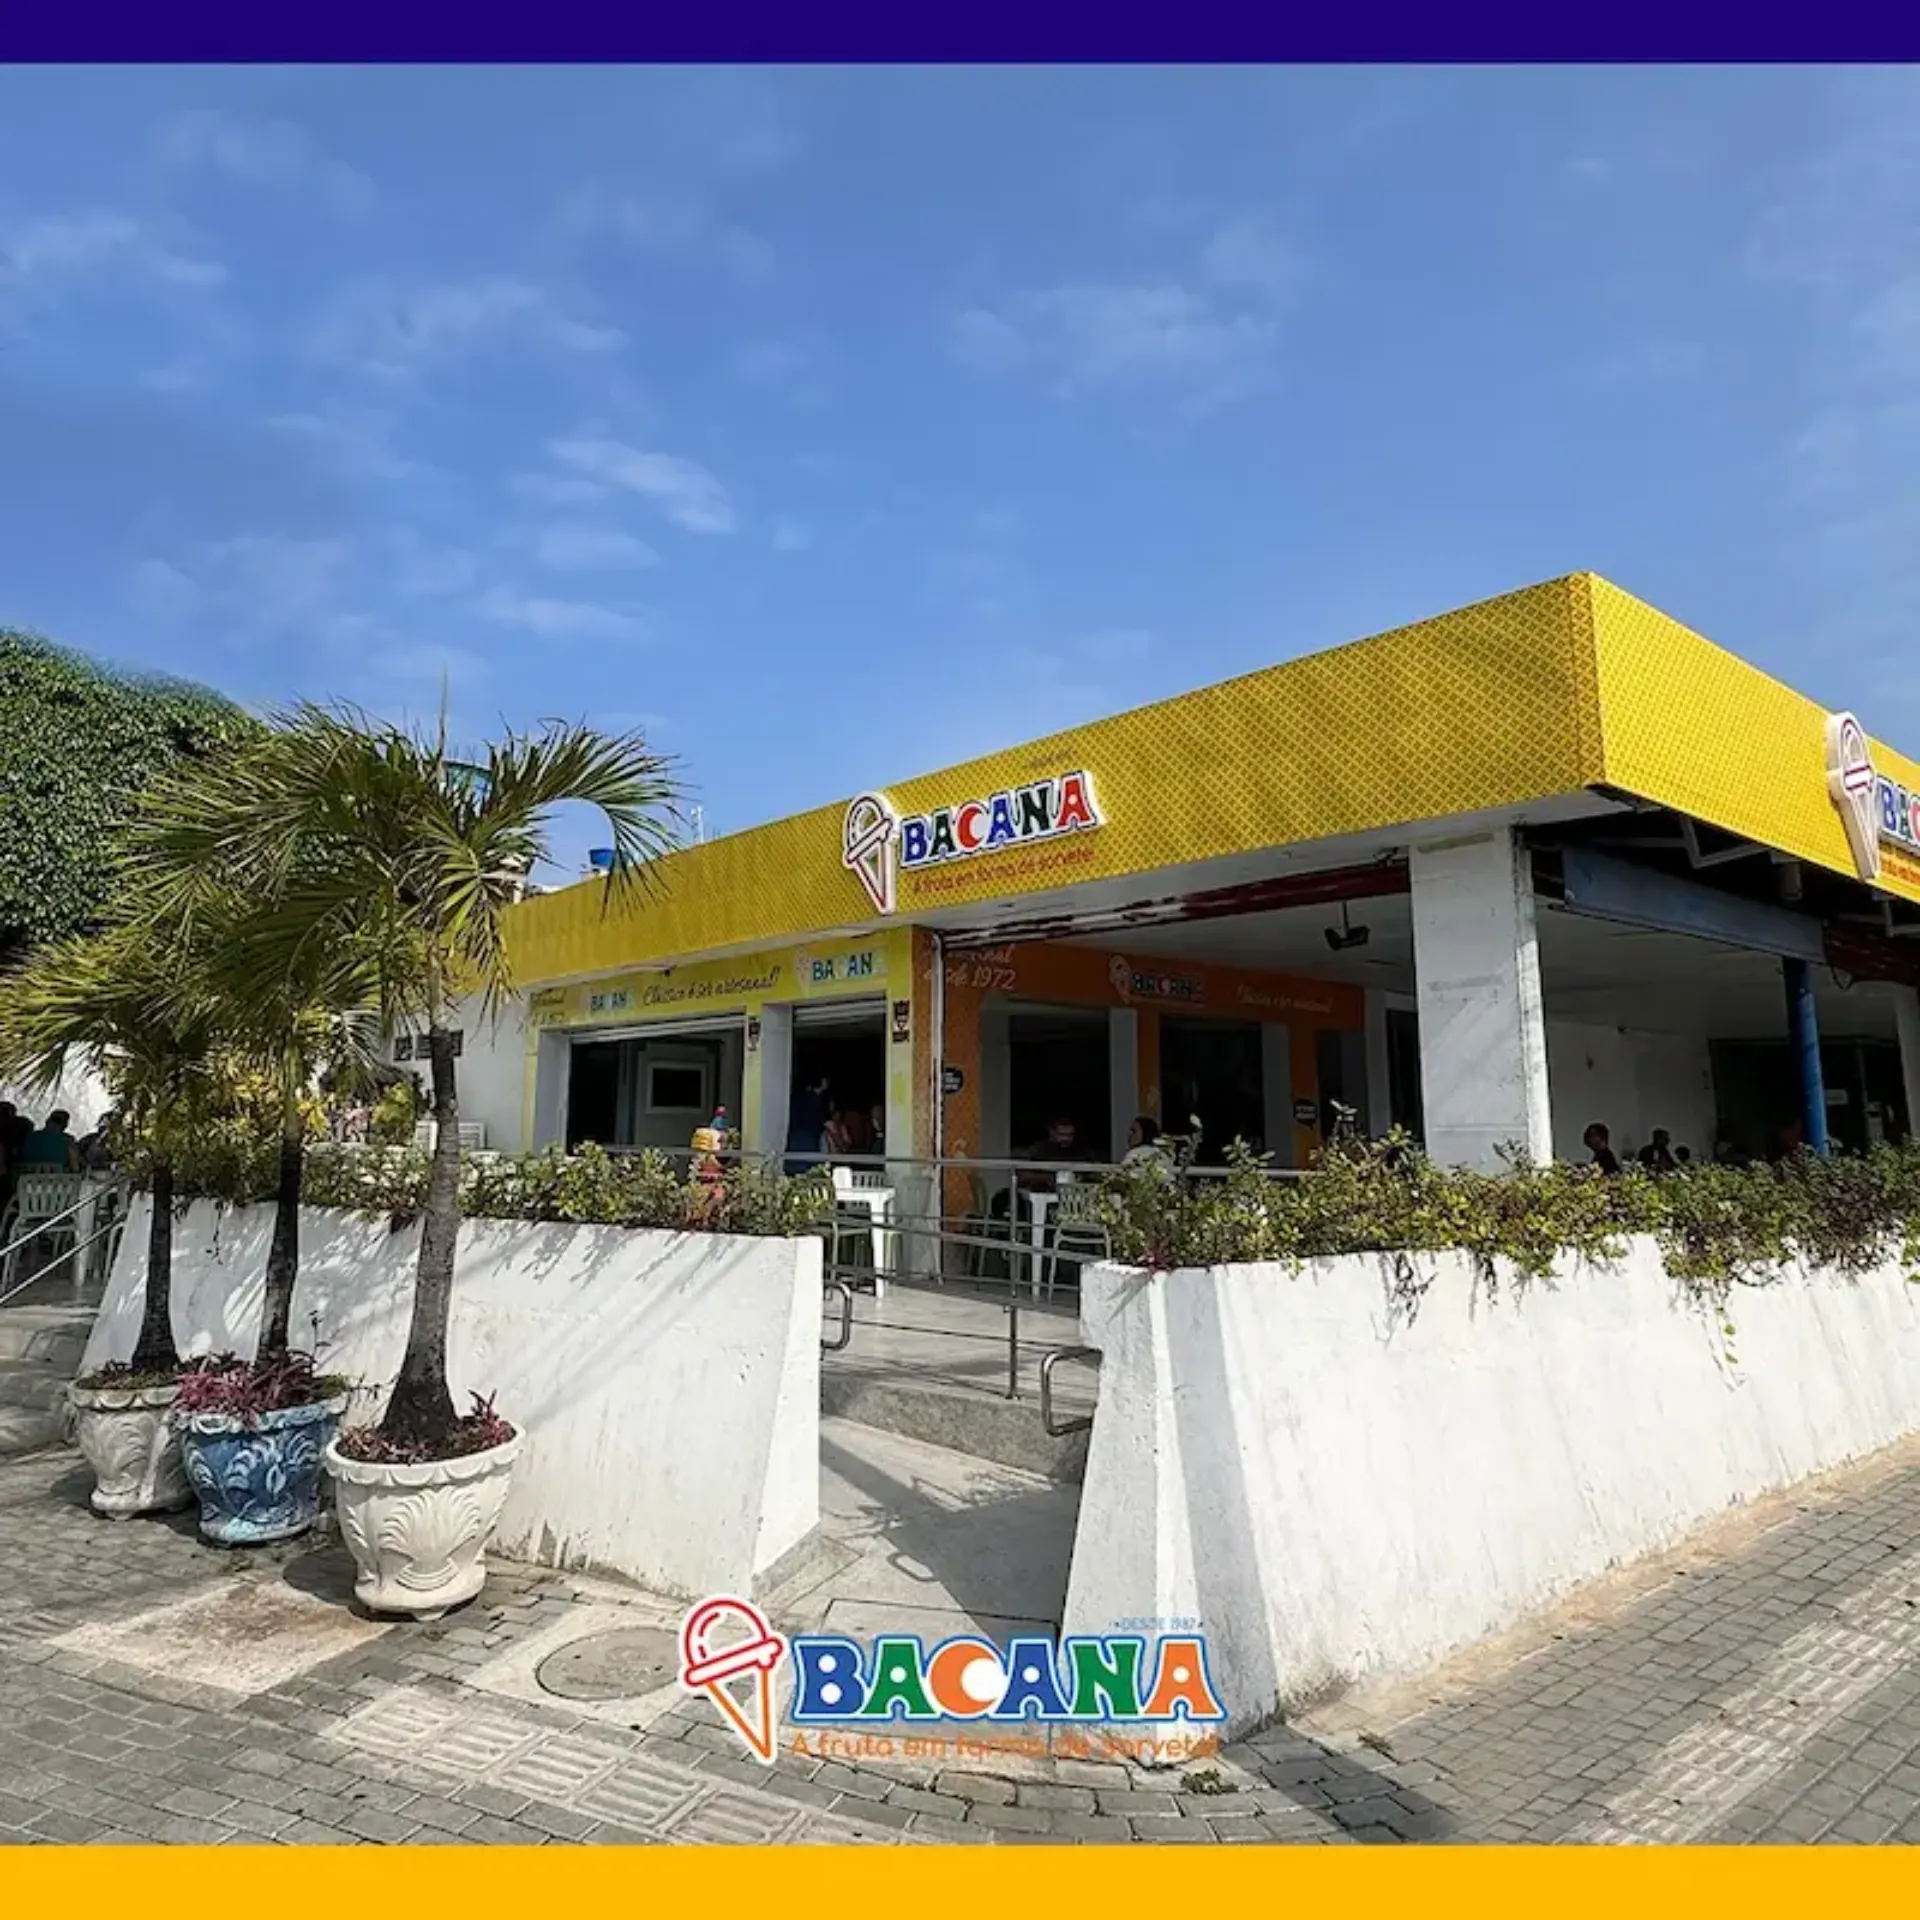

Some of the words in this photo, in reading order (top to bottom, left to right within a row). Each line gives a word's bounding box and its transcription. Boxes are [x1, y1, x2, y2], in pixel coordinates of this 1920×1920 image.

[902, 770, 1097, 868] BACANA
[813, 951, 887, 981] BAAN
[971, 965, 1017, 990] 1972
